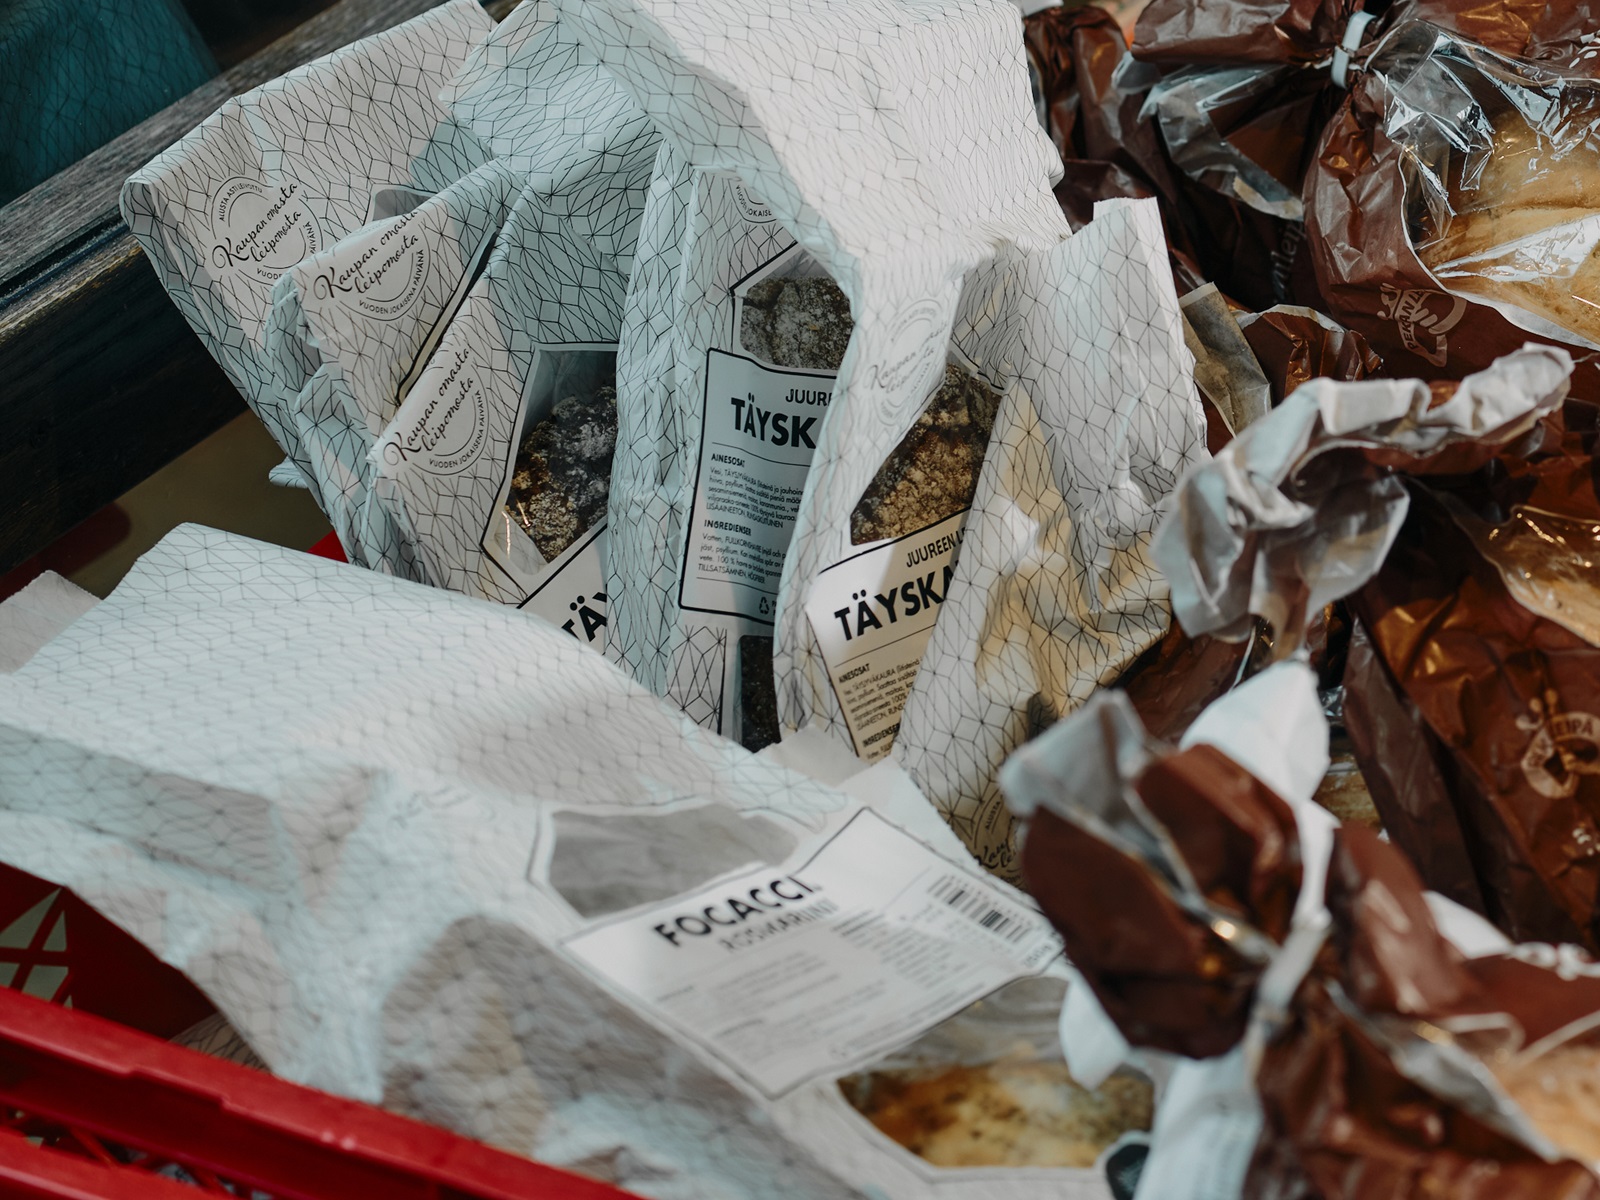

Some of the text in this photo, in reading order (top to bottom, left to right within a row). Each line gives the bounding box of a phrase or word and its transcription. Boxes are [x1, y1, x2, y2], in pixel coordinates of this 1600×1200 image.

[212, 183, 298, 268] Kaupan omasta
[314, 247, 378, 300] Kaupan
[360, 300, 389, 314] VUODEN
[383, 348, 469, 466] Kaupan omasta
[731, 392, 818, 450] TÄYSK
[429, 458, 458, 469] VUODEN
[906, 532, 956, 568] JUUREEN
[561, 592, 607, 642] TÄ
[654, 875, 816, 947] FOCACCI
